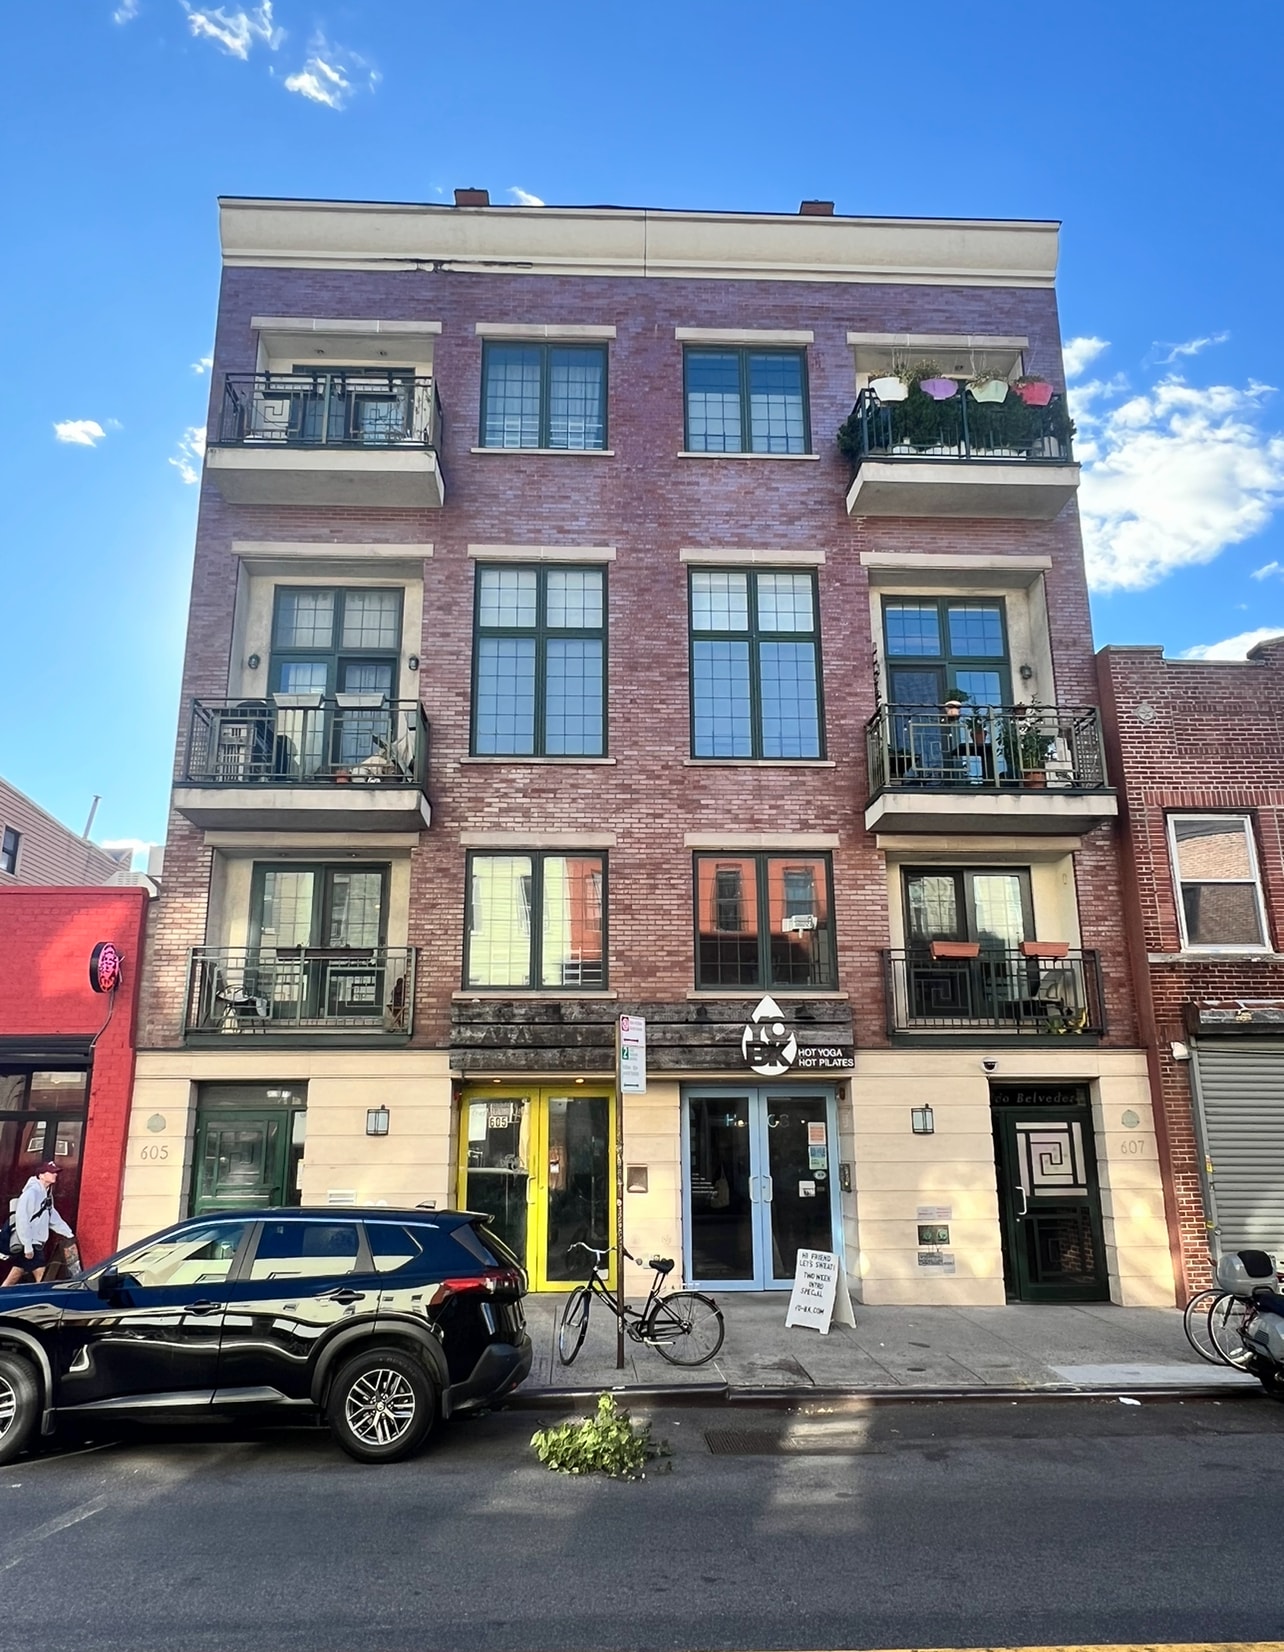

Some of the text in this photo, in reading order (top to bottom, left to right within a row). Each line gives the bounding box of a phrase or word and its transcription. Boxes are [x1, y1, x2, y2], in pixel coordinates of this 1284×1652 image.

[798, 1048, 843, 1057] HOT YOGA
[798, 1058, 854, 1067] HOT PILATES
[490, 1117, 507, 1128] 605
[1120, 1140, 1145, 1154] 607
[140, 1145, 169, 1160] 605
[811, 1253, 831, 1262] FRIEND
[804, 1271, 831, 1282] TWO WEEK
[809, 1281, 824, 1290] INTRO
[800, 1288, 823, 1297] SPECIAL
